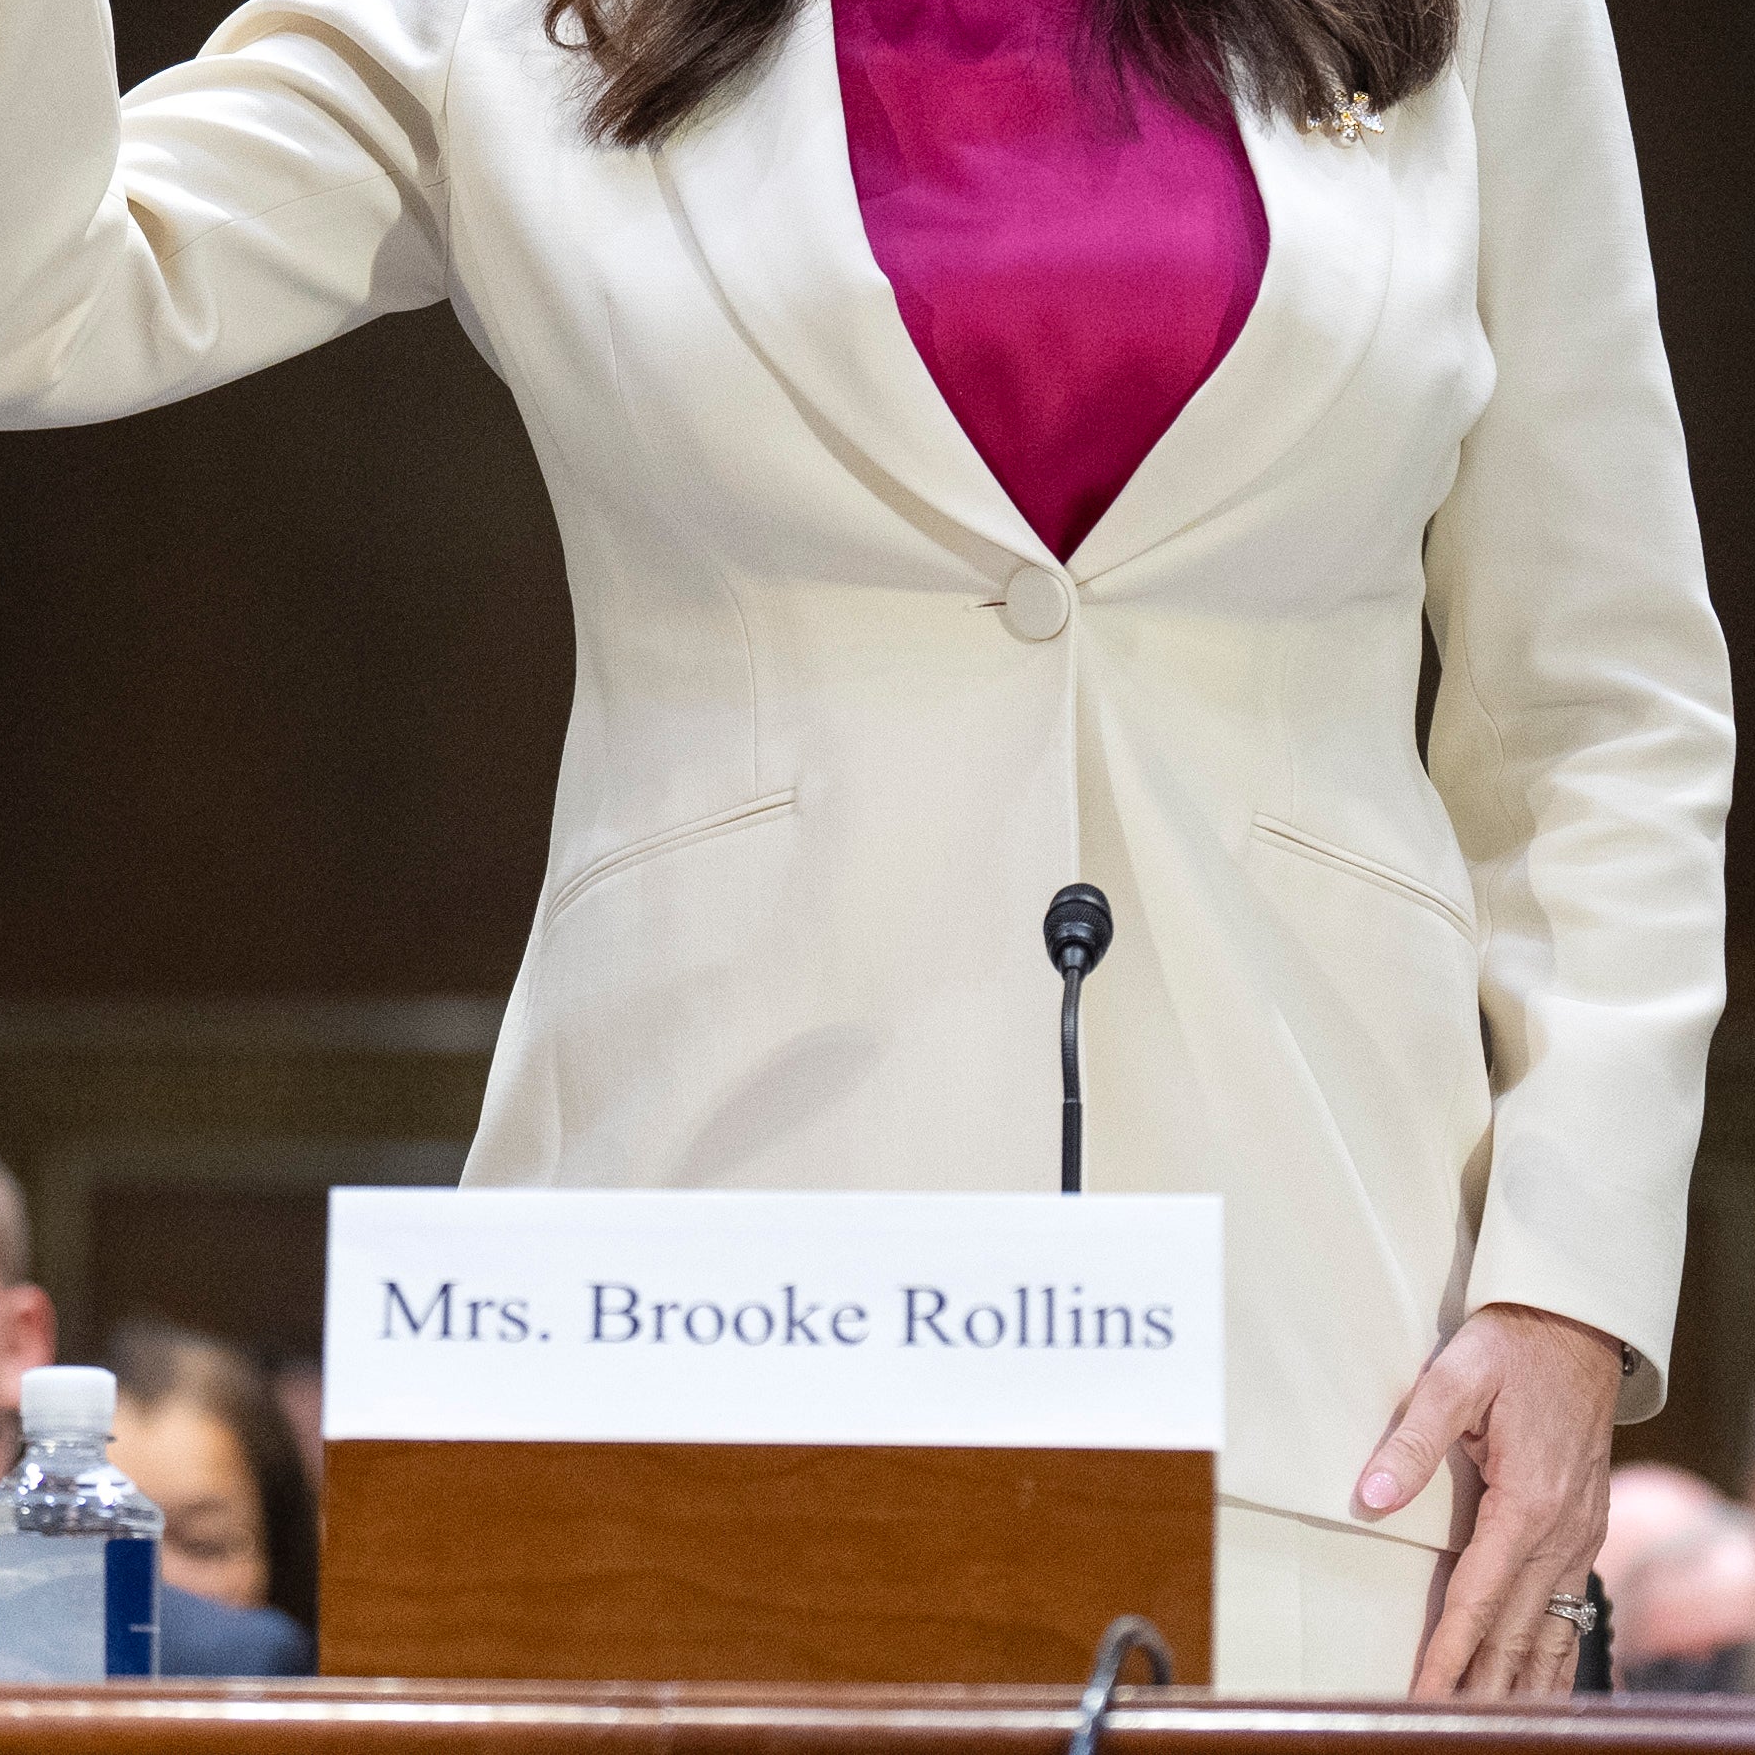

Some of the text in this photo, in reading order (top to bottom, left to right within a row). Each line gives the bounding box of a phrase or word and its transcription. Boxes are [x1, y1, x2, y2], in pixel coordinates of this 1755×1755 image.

[380, 1280, 1175, 1349] Mrs. Brooke Rollins
